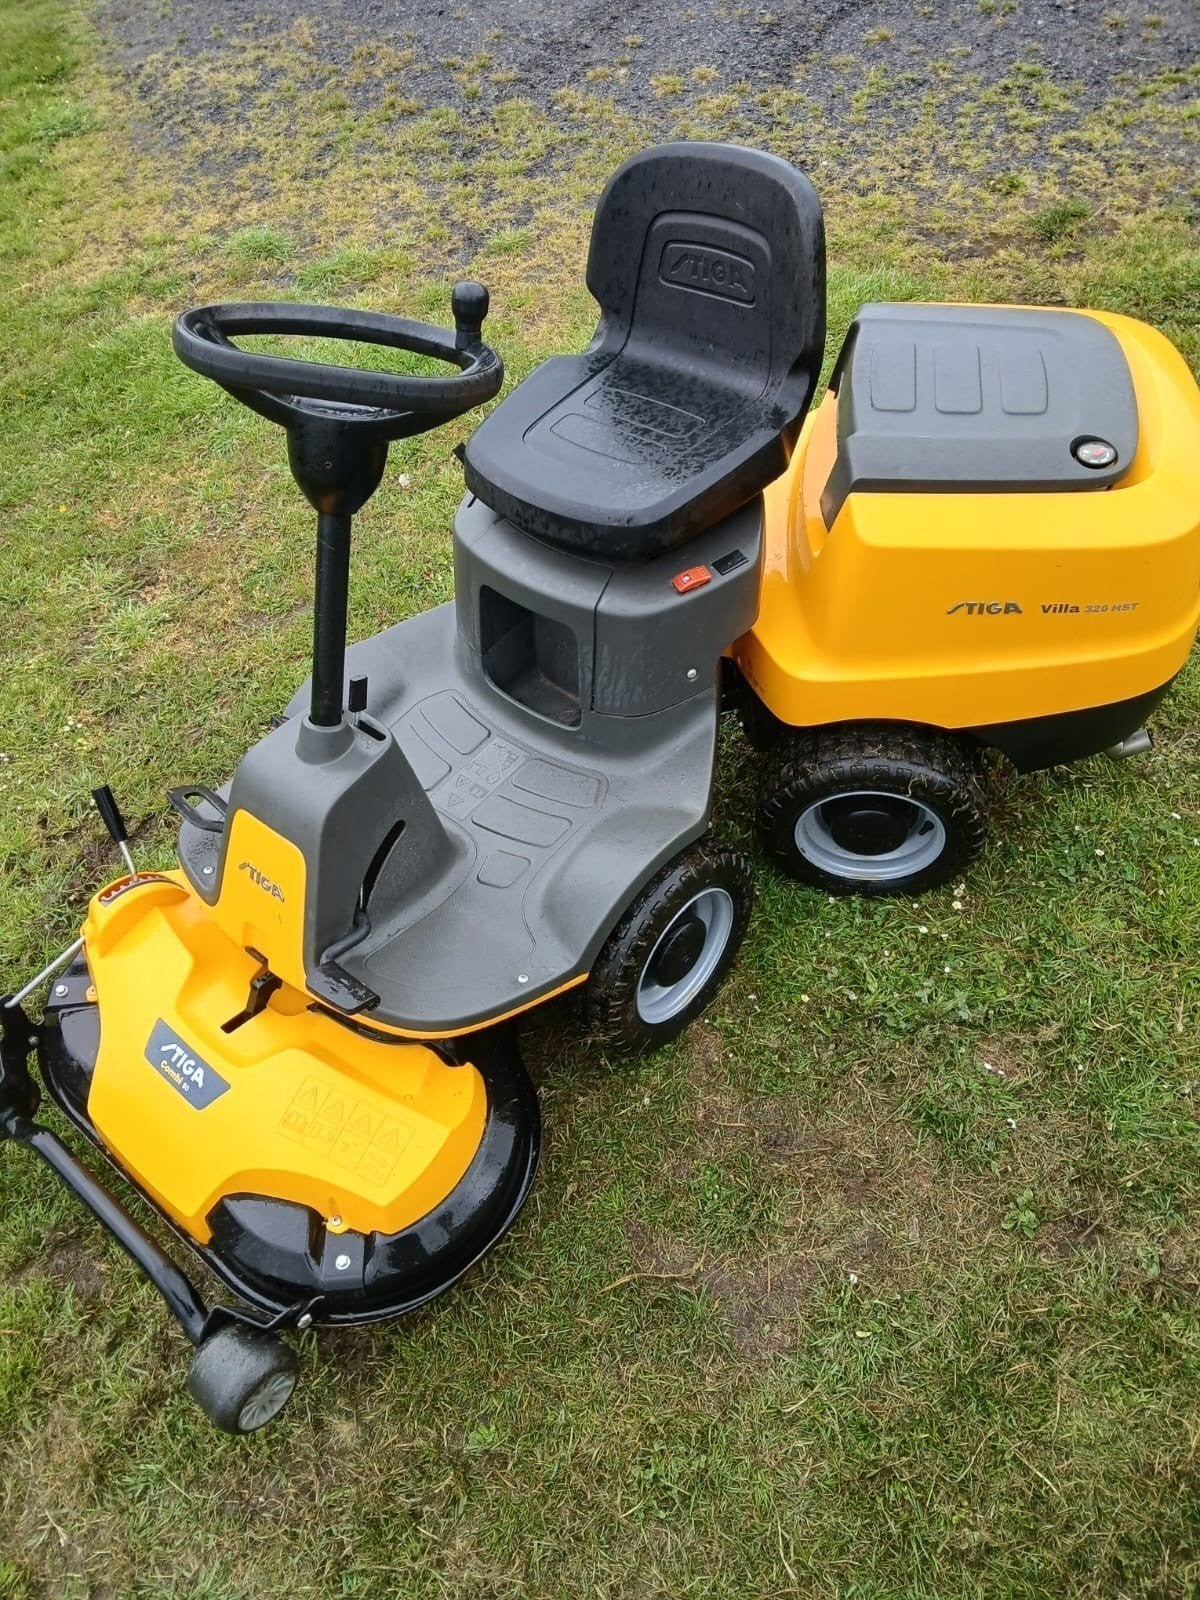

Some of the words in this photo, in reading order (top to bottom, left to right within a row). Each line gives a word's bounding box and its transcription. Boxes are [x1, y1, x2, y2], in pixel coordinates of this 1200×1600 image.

[669, 253, 748, 293] STIGA
[946, 602, 1023, 615] STIGA
[1041, 603, 1080, 614] Villa
[1085, 604, 1108, 613] 320
[1111, 602, 1140, 612] HST
[238, 862, 285, 903] STIGA
[160, 1043, 205, 1089] STIGA
[160, 1059, 185, 1085] Combi
